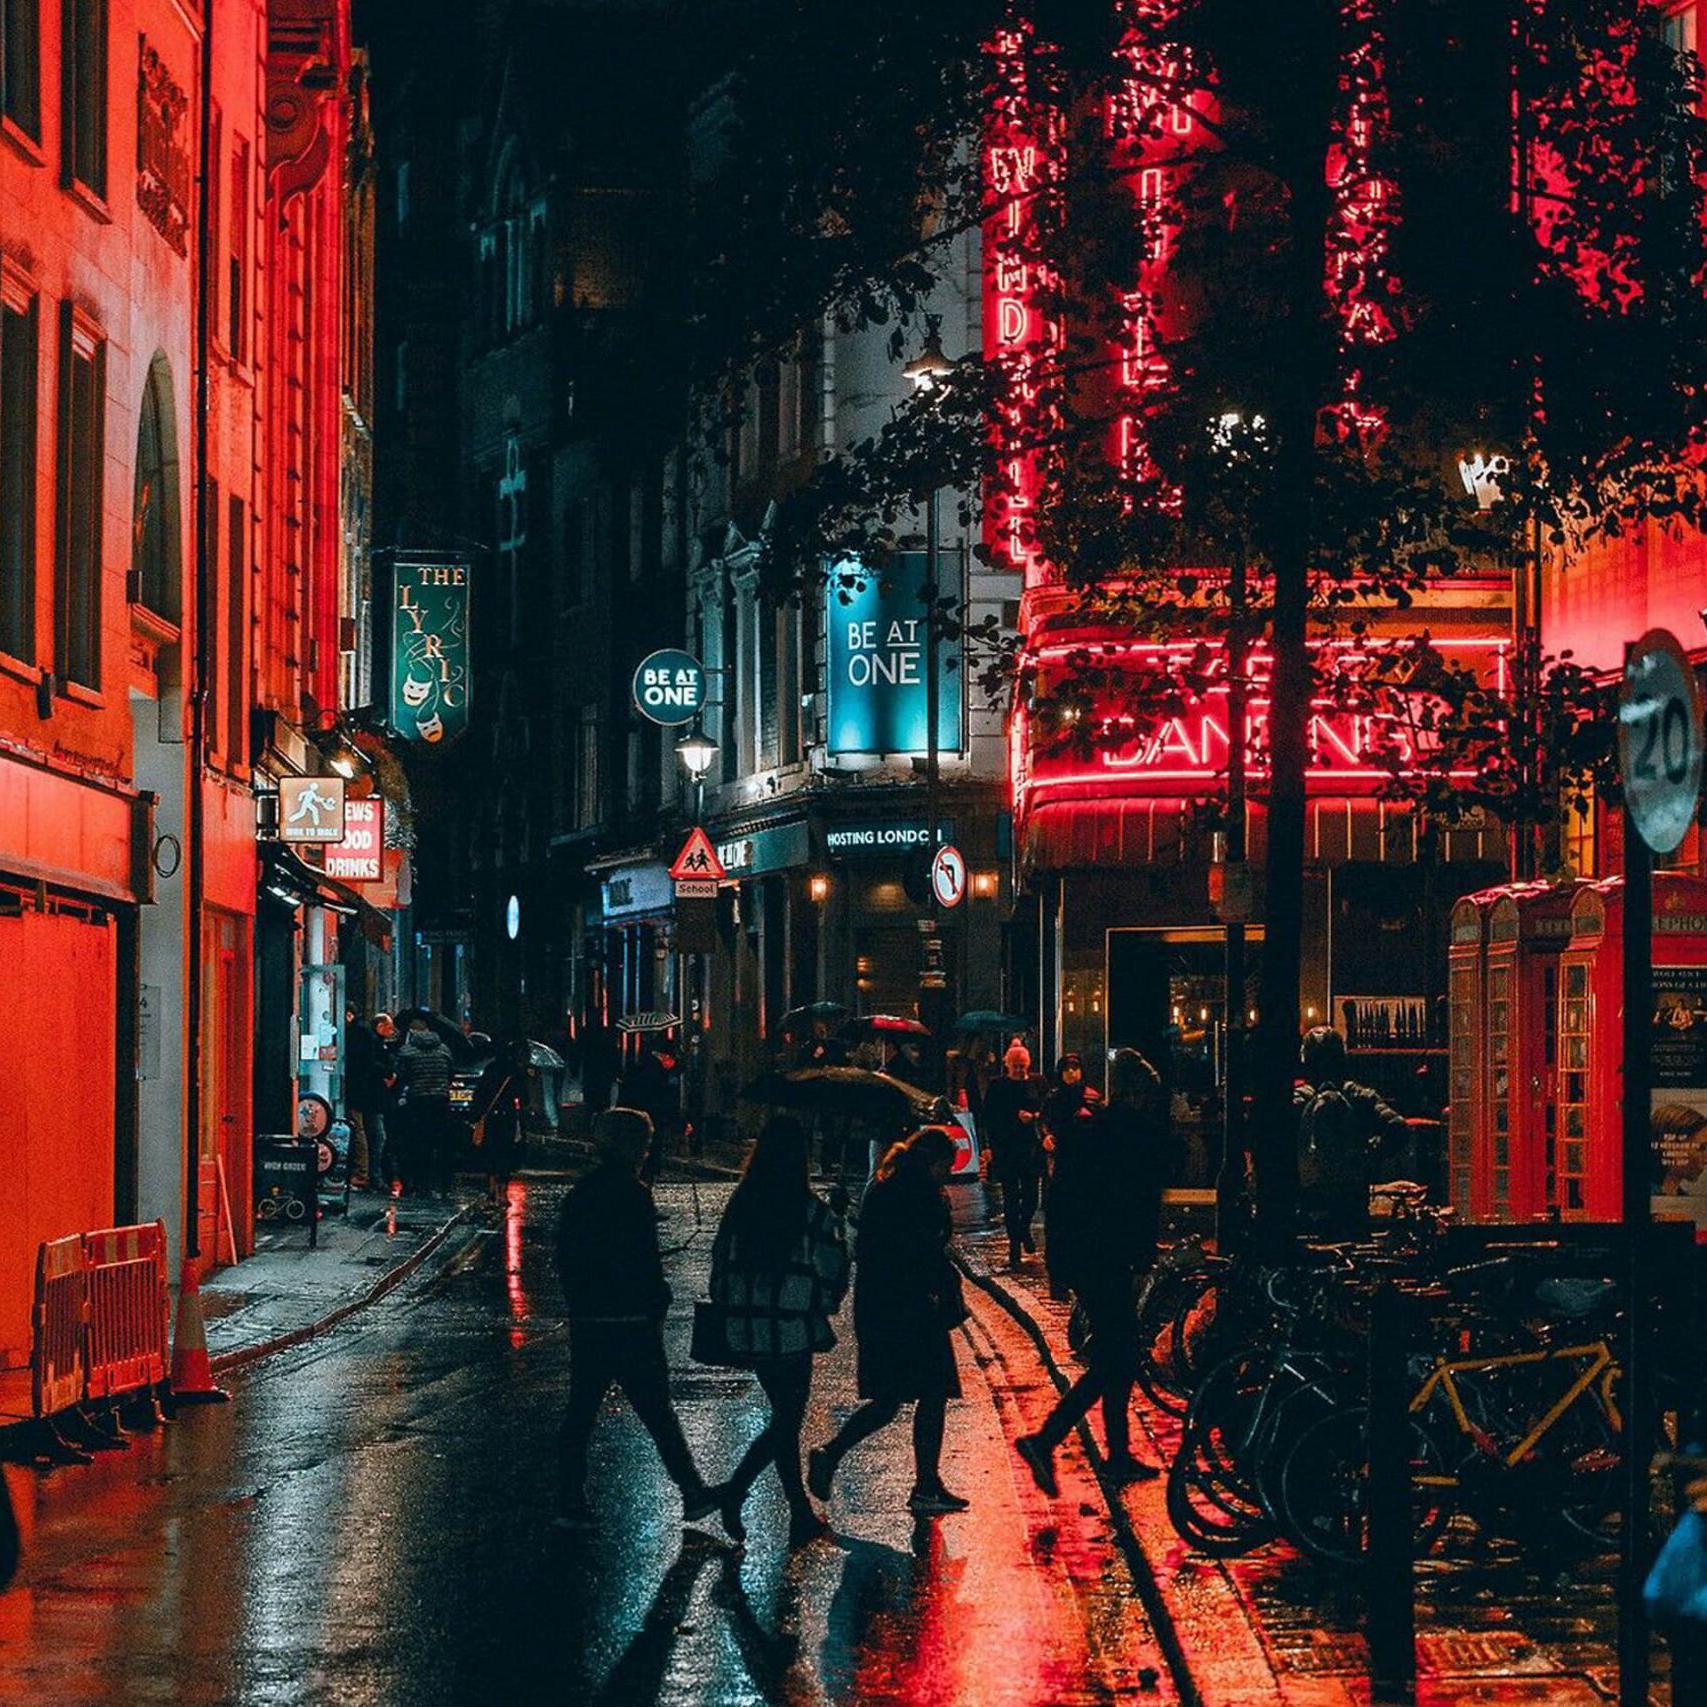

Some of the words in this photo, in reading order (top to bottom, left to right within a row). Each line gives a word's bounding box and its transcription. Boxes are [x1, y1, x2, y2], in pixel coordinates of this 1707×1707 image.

[991, 146, 1036, 563] WINDLL
[417, 567, 465, 586] THE
[848, 621, 877, 650] BE
[886, 620, 921, 647] AT
[399, 585, 465, 708] LYRIC
[644, 668, 671, 686] BE
[675, 668, 698, 686] AT
[848, 652, 921, 687] ONE
[644, 686, 698, 706] ONE
[1633, 694, 1688, 785] 20
[345, 801, 374, 822] EWS
[333, 829, 372, 850] OOD
[827, 831, 874, 847] HOSTING
[325, 858, 379, 878] DRINKS
[679, 884, 714, 894] School
